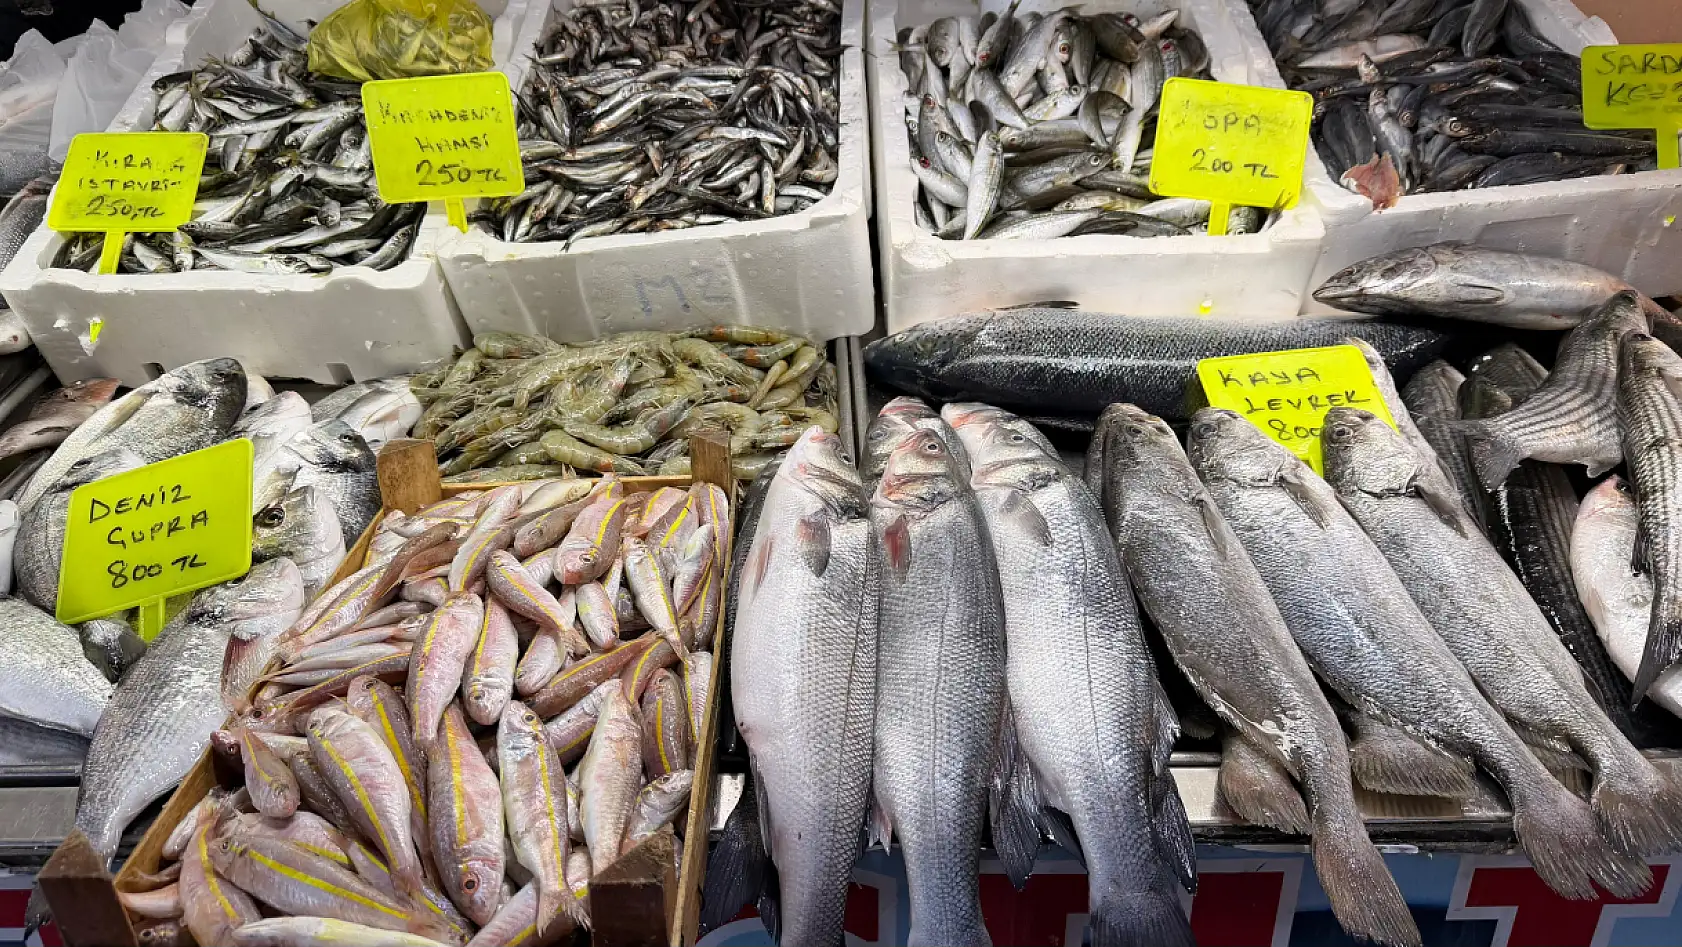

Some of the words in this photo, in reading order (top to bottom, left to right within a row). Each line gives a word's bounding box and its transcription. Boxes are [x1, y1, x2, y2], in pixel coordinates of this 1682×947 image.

[1595, 51, 1682, 75] SARD
[416, 159, 472, 186] 250
[1189, 148, 1234, 173] 200
[1243, 163, 1279, 179] TL
[1218, 367, 1321, 387] KAYA
[1244, 390, 1371, 414] LEVREK
[107, 560, 163, 589] 800
[171, 554, 207, 572] TL
